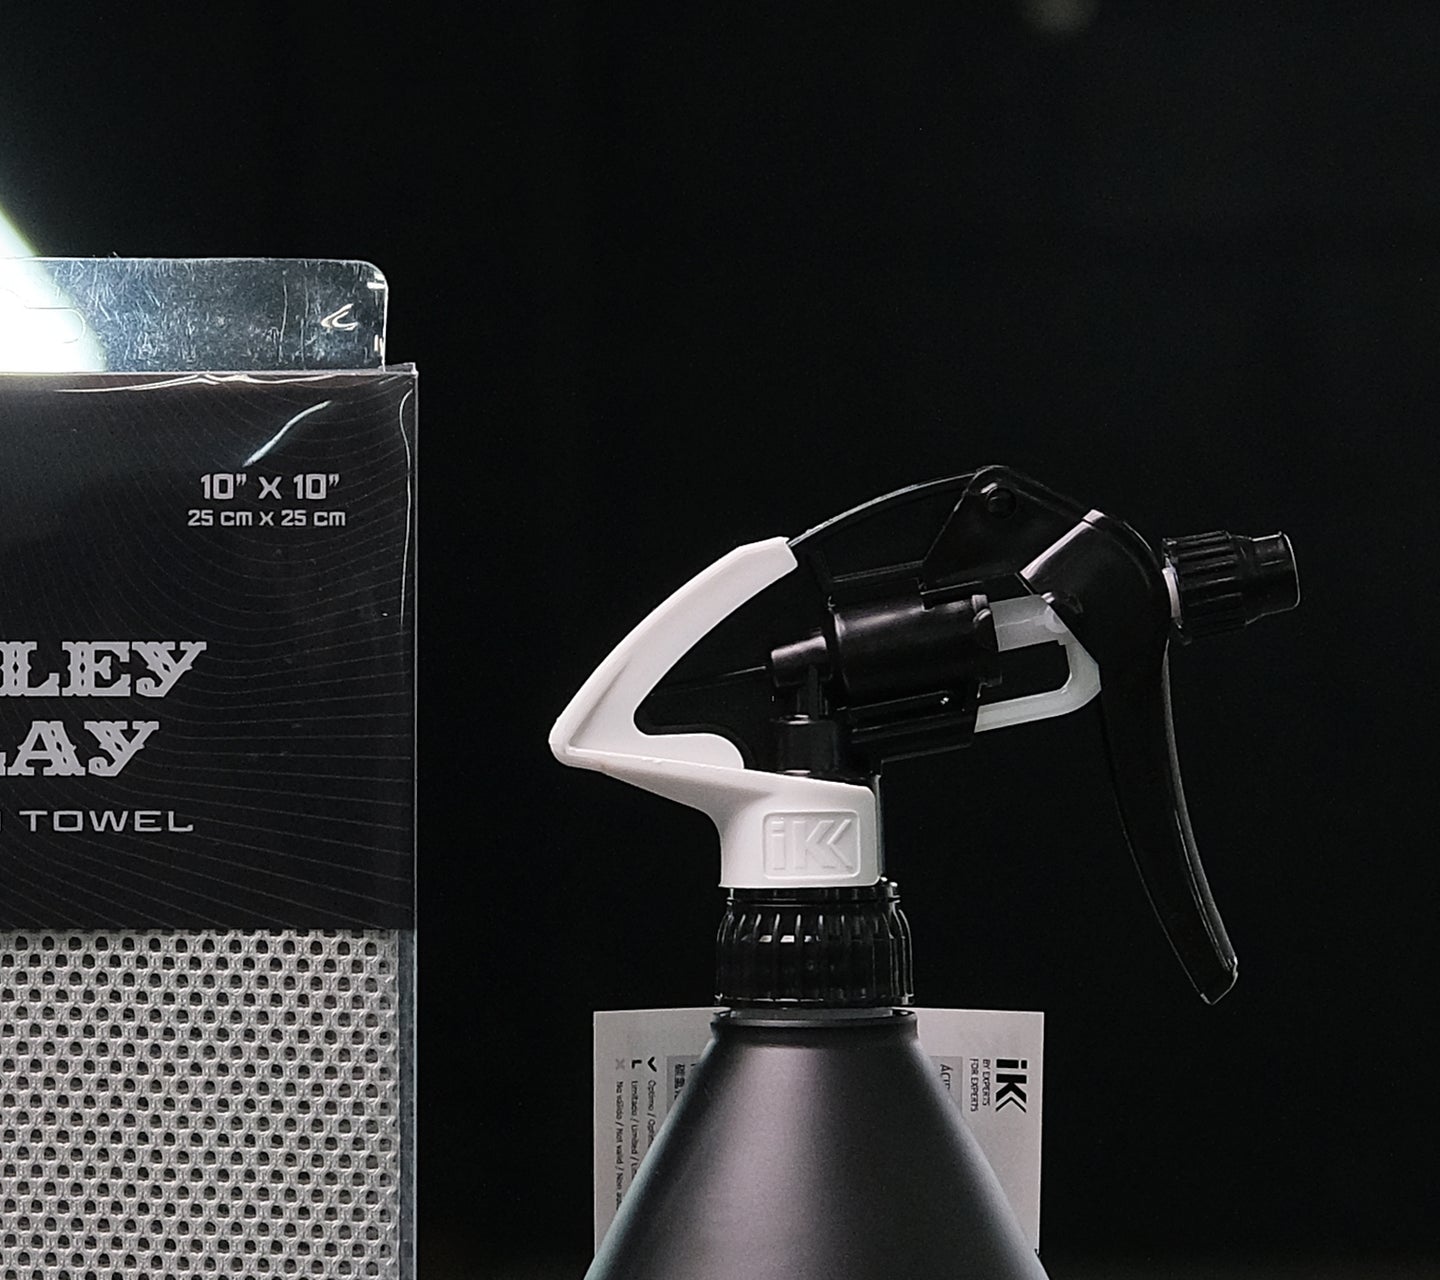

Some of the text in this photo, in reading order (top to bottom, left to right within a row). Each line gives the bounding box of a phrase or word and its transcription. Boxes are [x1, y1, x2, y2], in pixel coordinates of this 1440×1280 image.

[200, 473, 247, 500] 10"
[293, 473, 340, 500] 10"
[19, 810, 194, 832] TOWEL
[631, 1059, 642, 1069] L
[970, 1058, 979, 1113] FOR EXPERTS
[982, 1071, 991, 1107] EXPERTS
